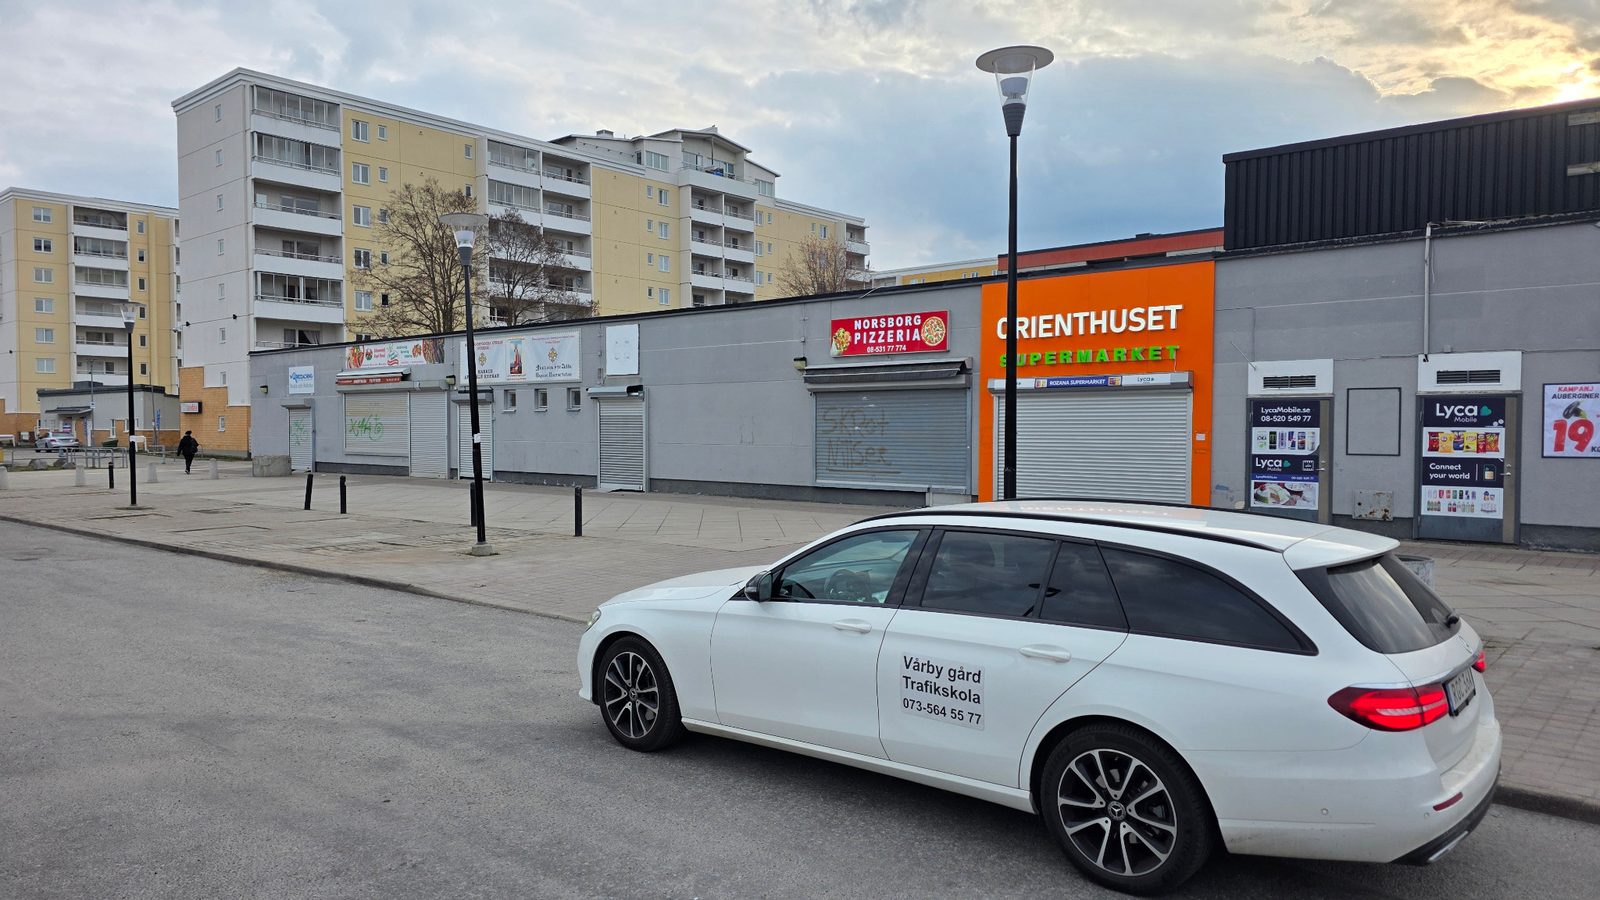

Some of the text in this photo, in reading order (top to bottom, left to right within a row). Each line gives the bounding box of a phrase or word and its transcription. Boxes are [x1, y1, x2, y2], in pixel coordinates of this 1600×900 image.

[854, 315, 922, 330] NORSBORG
[996, 304, 1184, 340] ORIENTHUSET
[854, 329, 921, 344] PIZZERIA
[895, 344, 907, 352] 774
[999, 345, 1180, 368] SUPERMARKET
[1070, 378, 1106, 386] SUPERMARKET
[1260, 406, 1311, 414] LycaMobile.se
[1436, 403, 1478, 419] Lyca
[1553, 418, 1594, 453] 19
[1255, 457, 1282, 469] Lyca
[1429, 462, 1462, 470] Connect
[903, 655, 982, 684] Vårby gård
[902, 675, 981, 704] Trafikskola
[903, 697, 982, 725] 073-564 55 77
